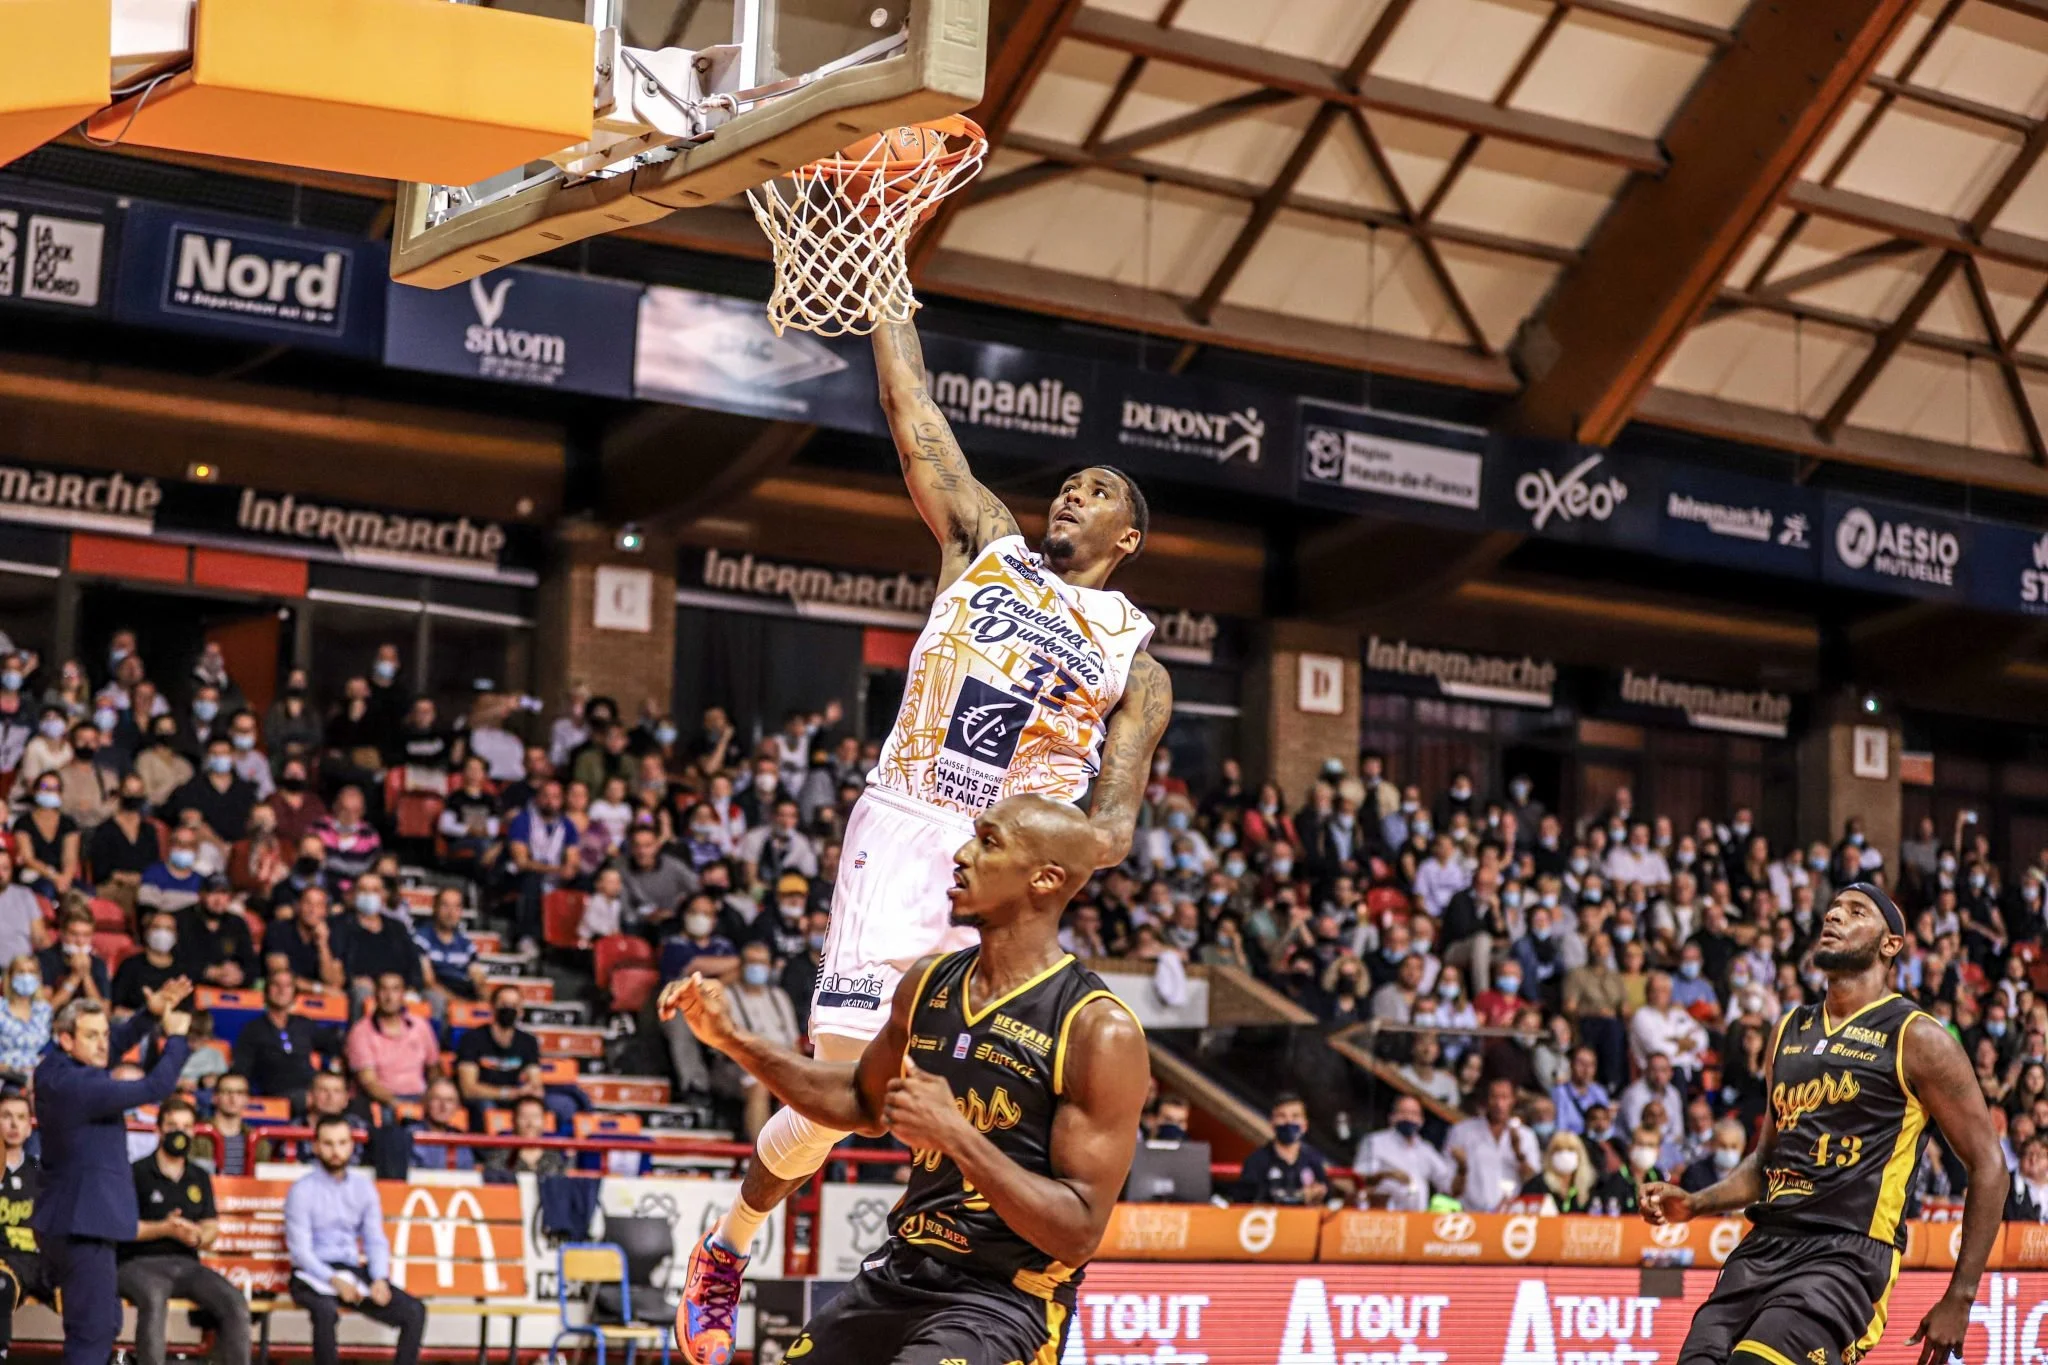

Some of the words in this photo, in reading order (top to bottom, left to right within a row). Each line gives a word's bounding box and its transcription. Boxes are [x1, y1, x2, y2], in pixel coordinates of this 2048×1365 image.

[177, 233, 343, 310] Nord
[1122, 400, 1231, 443] DUPONT
[1874, 555, 1954, 587] MUTUELLE
[611, 576, 635, 614] C
[969, 585, 1088, 650] Gravelines
[969, 614, 1099, 686] Dunkerque
[1312, 667, 1332, 699] D
[938, 766, 979, 792] HAUTS
[981, 783, 999, 797] DE
[939, 757, 965, 772] CAISSE
[936, 781, 996, 809] FRANCE
[994, 1012, 1054, 1050] HECTARE
[988, 1050, 1037, 1080] EIFFAGE
[1841, 1047, 1878, 1063] EIFFAGE
[1808, 1132, 1864, 1168] 43
[925, 1219, 944, 1237] SUR
[944, 1228, 969, 1247] MER
[1083, 1294, 1210, 1340] TOUT
[1332, 1294, 1450, 1340] TOUT
[1554, 1295, 1662, 1340] TOUT
